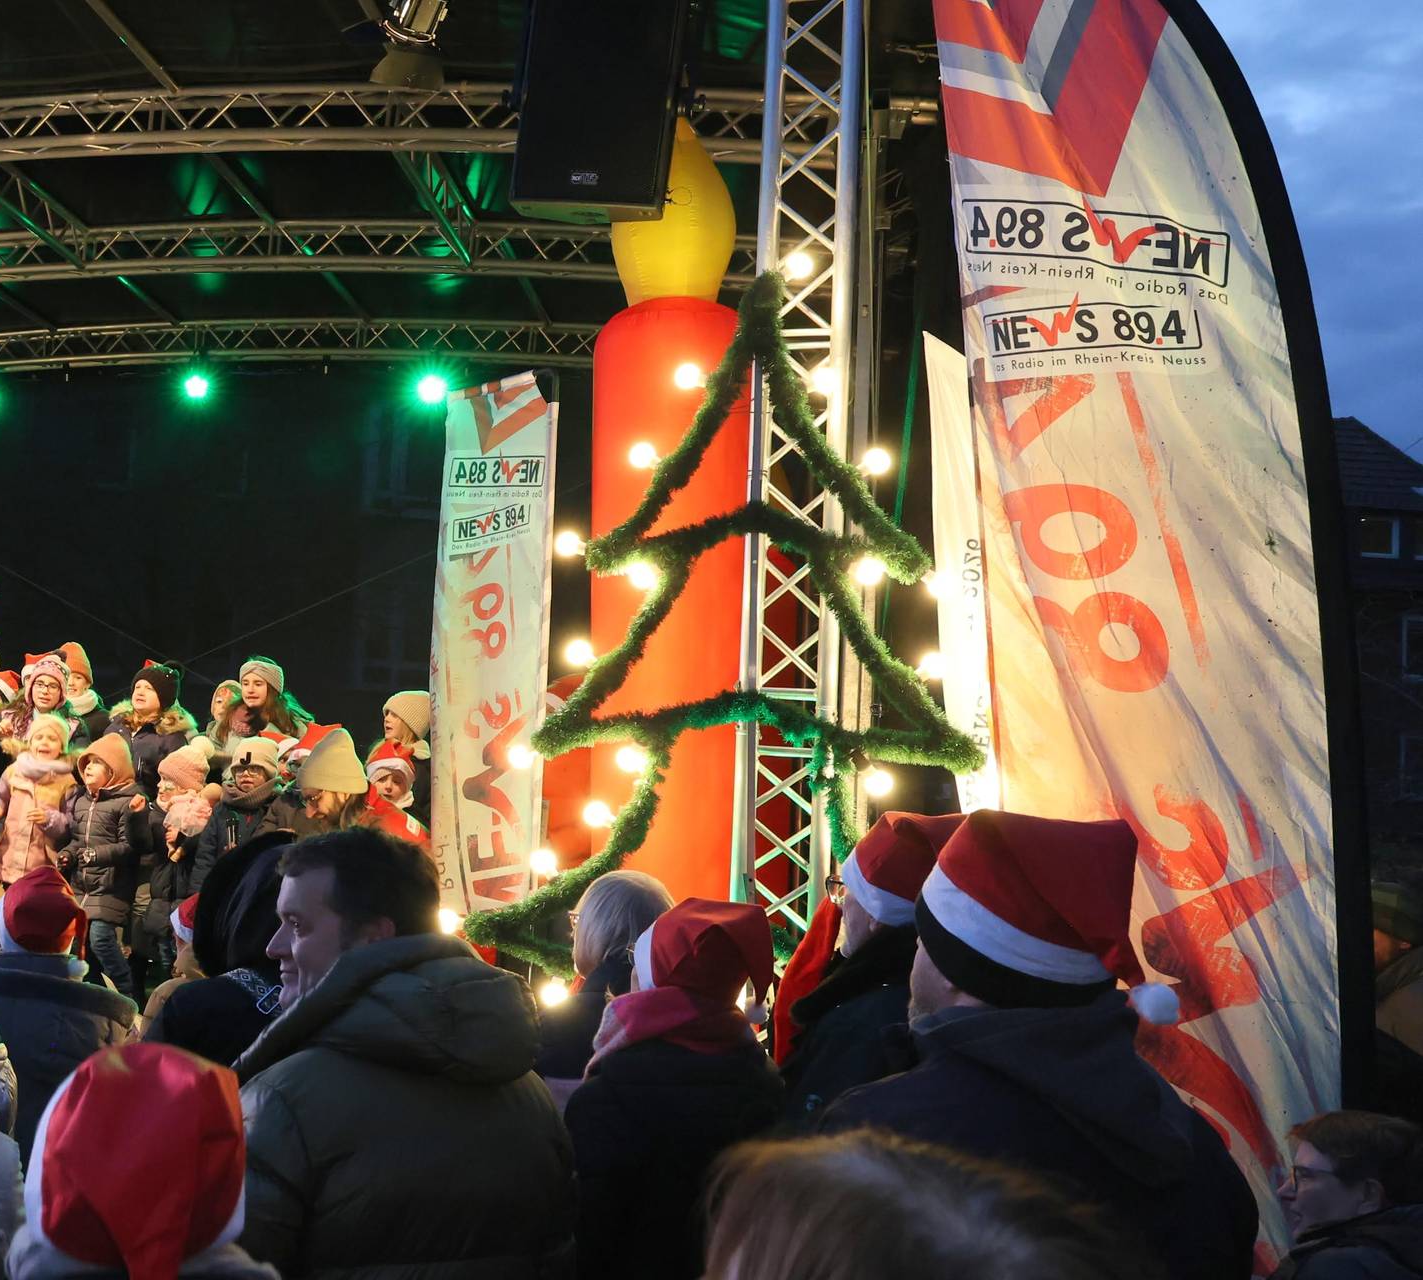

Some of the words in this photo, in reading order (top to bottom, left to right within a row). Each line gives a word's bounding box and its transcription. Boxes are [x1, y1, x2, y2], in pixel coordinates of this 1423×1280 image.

[1112, 308, 1186, 346] 89.4
[1011, 358, 1044, 371] Radio
[1052, 357, 1066, 367] im
[1074, 351, 1155, 366] Rhein-Kreis
[1162, 354, 1207, 367] Neuss
[504, 505, 525, 529] 89.4
[239, 751, 252, 767] J
